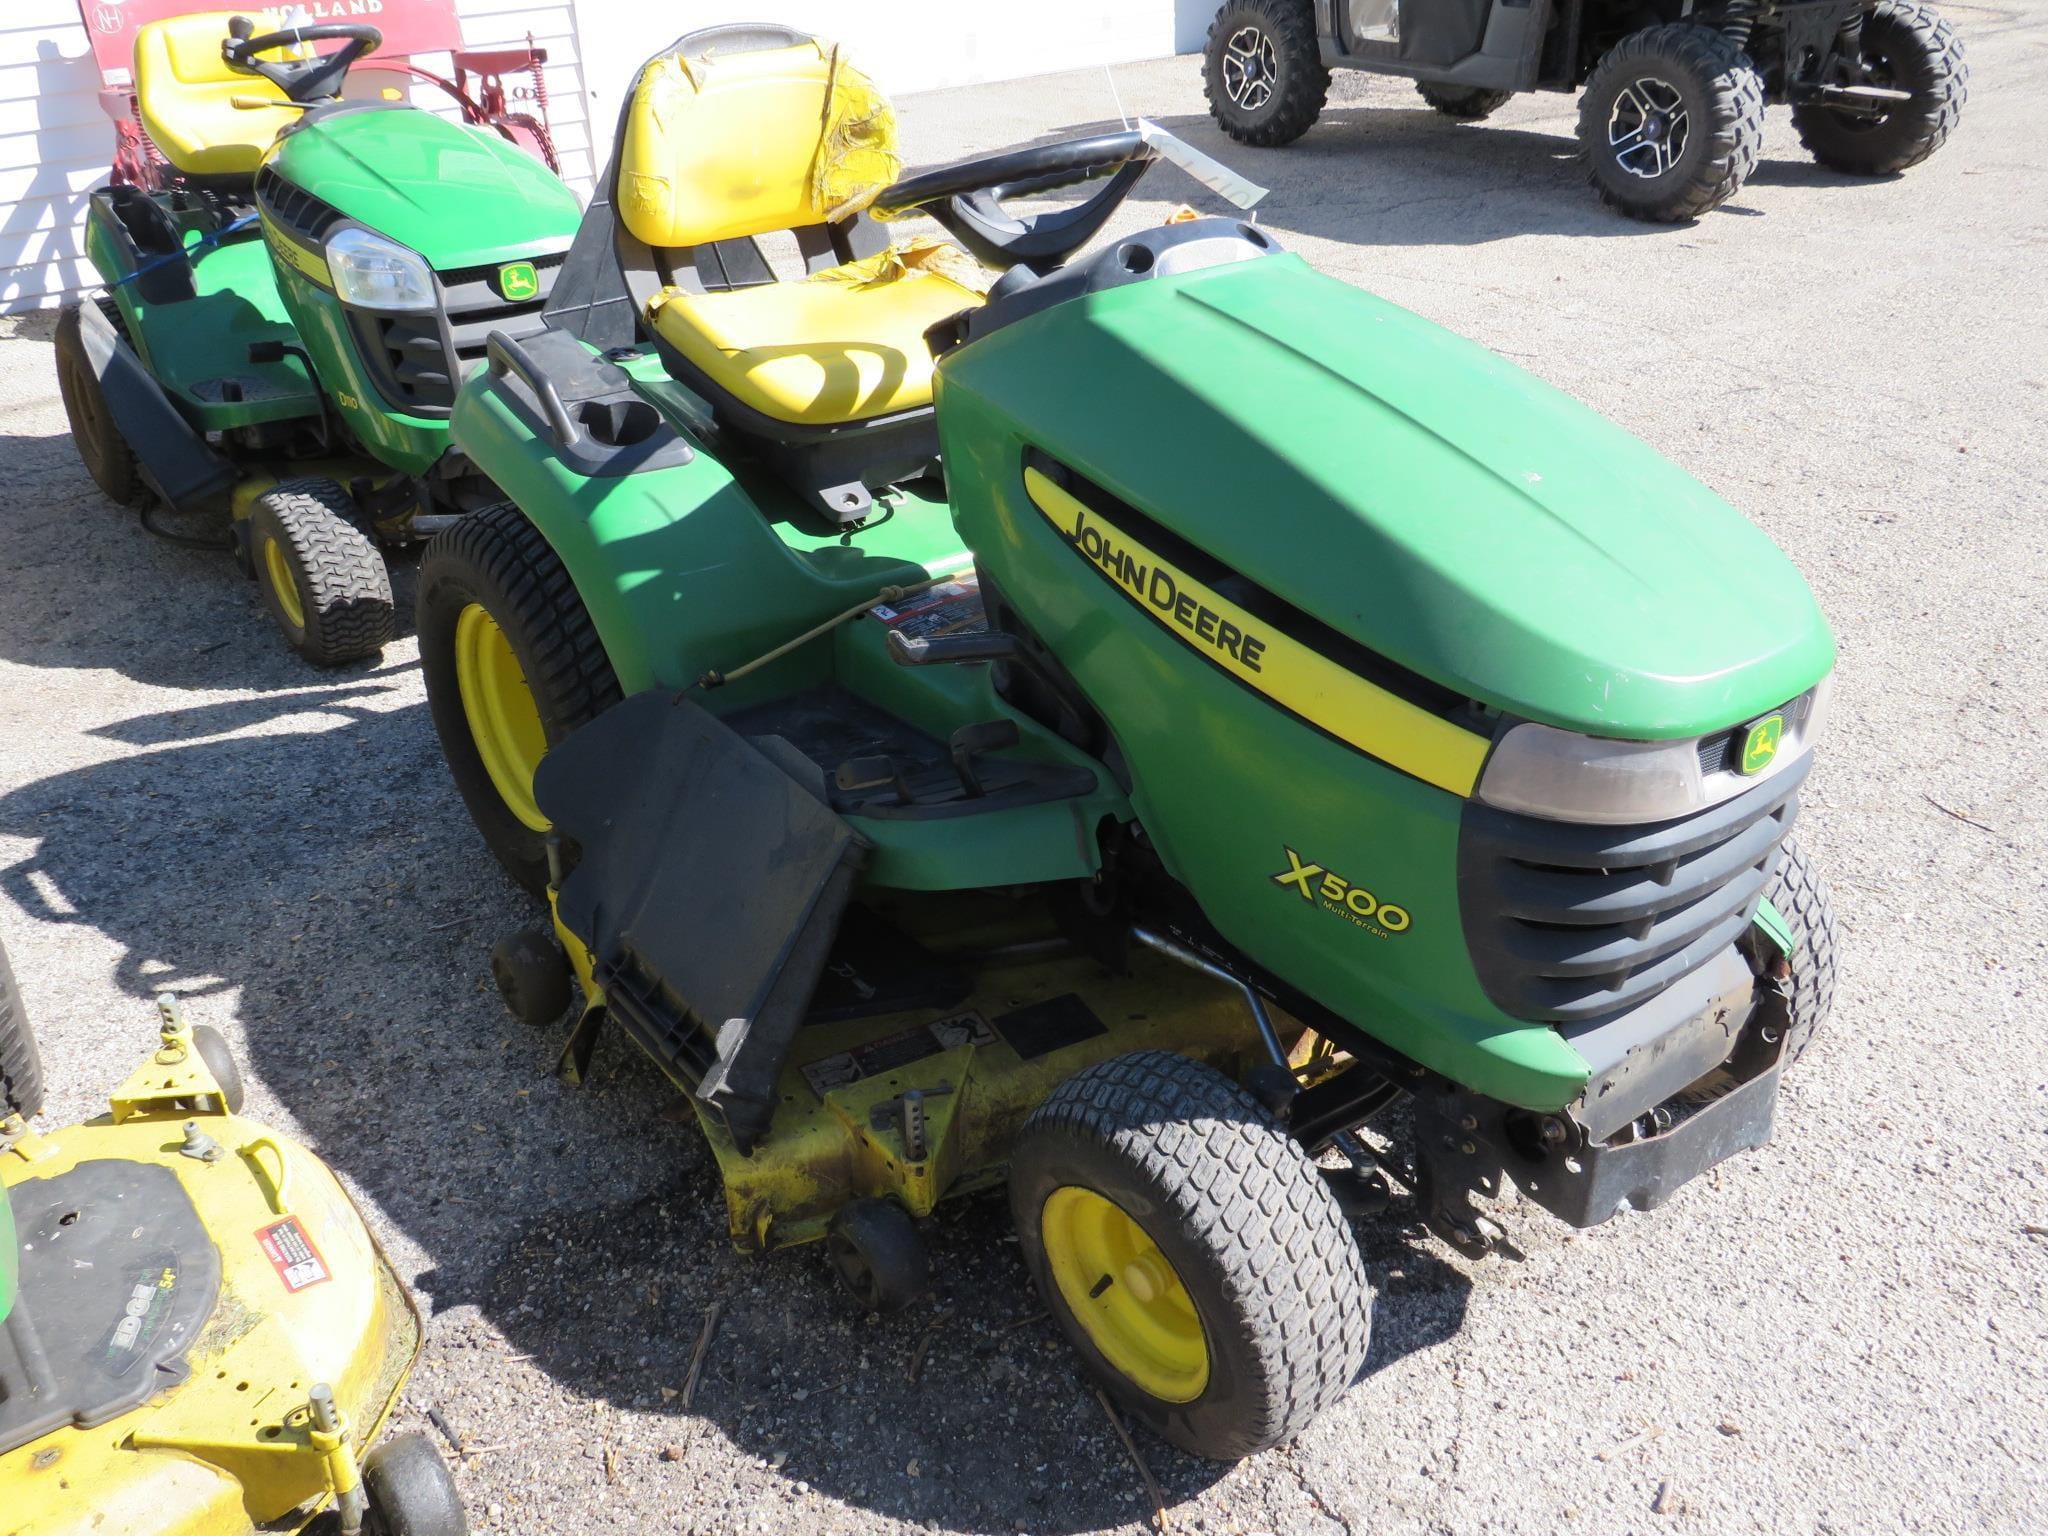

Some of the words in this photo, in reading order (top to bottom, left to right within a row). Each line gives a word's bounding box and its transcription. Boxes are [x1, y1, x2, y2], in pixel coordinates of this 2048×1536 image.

[1066, 511, 1147, 595] JOHN
[1148, 567, 1267, 674] DEERE
[1271, 845, 1412, 933] X500
[1322, 900, 1388, 939] Multi-Terrain
[110, 1284, 157, 1351] EDGE
